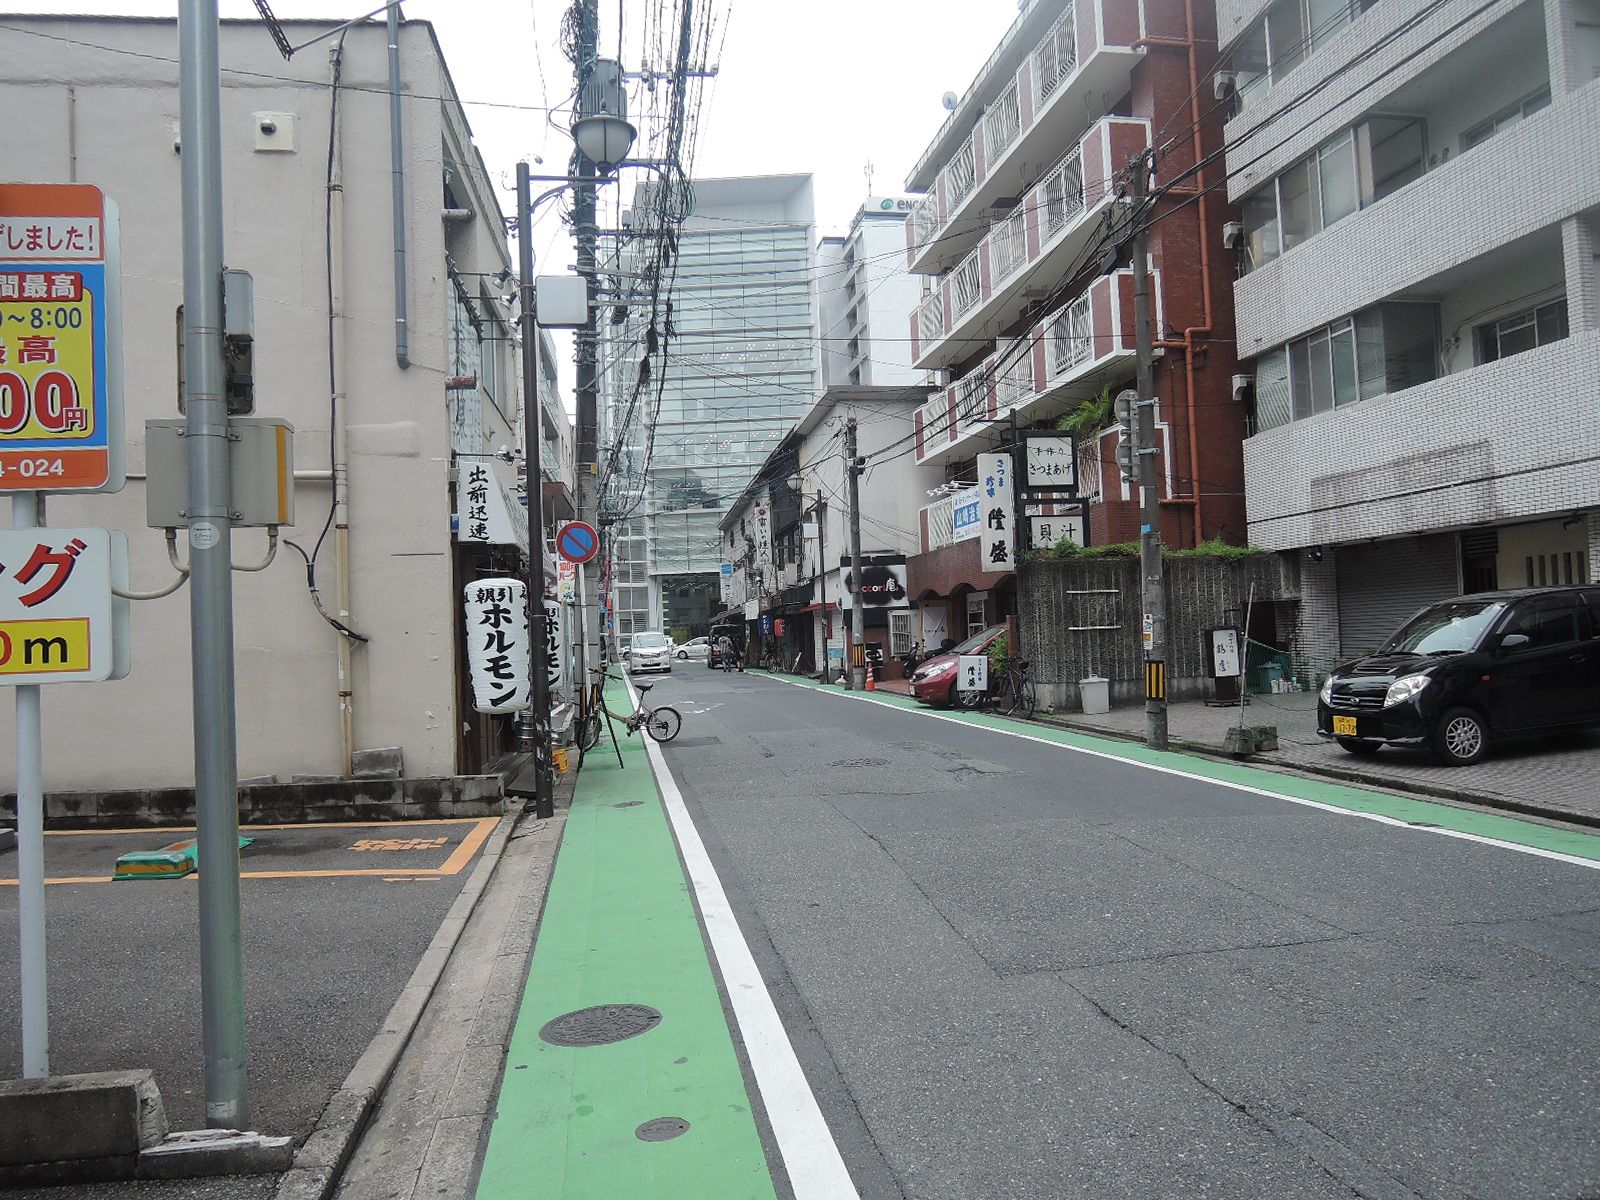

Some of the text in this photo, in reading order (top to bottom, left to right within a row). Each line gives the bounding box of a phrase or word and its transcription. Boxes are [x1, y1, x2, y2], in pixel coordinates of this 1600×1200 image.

[0, 223, 94, 252] しました!
[0, 273, 75, 299] 間最高
[0, 306, 82, 329] ～8:00
[0, 333, 56, 364] 高
[1033, 446, 1066, 457] 手作り
[1029, 462, 1073, 476] さつまあげ
[466, 465, 490, 541] 出前迅速
[987, 506, 1009, 564] 隆盛
[1040, 522, 1078, 542] 貝汁
[0, 537, 89, 608] グ
[475, 586, 514, 604] 朝引
[478, 603, 518, 708] ホルモン
